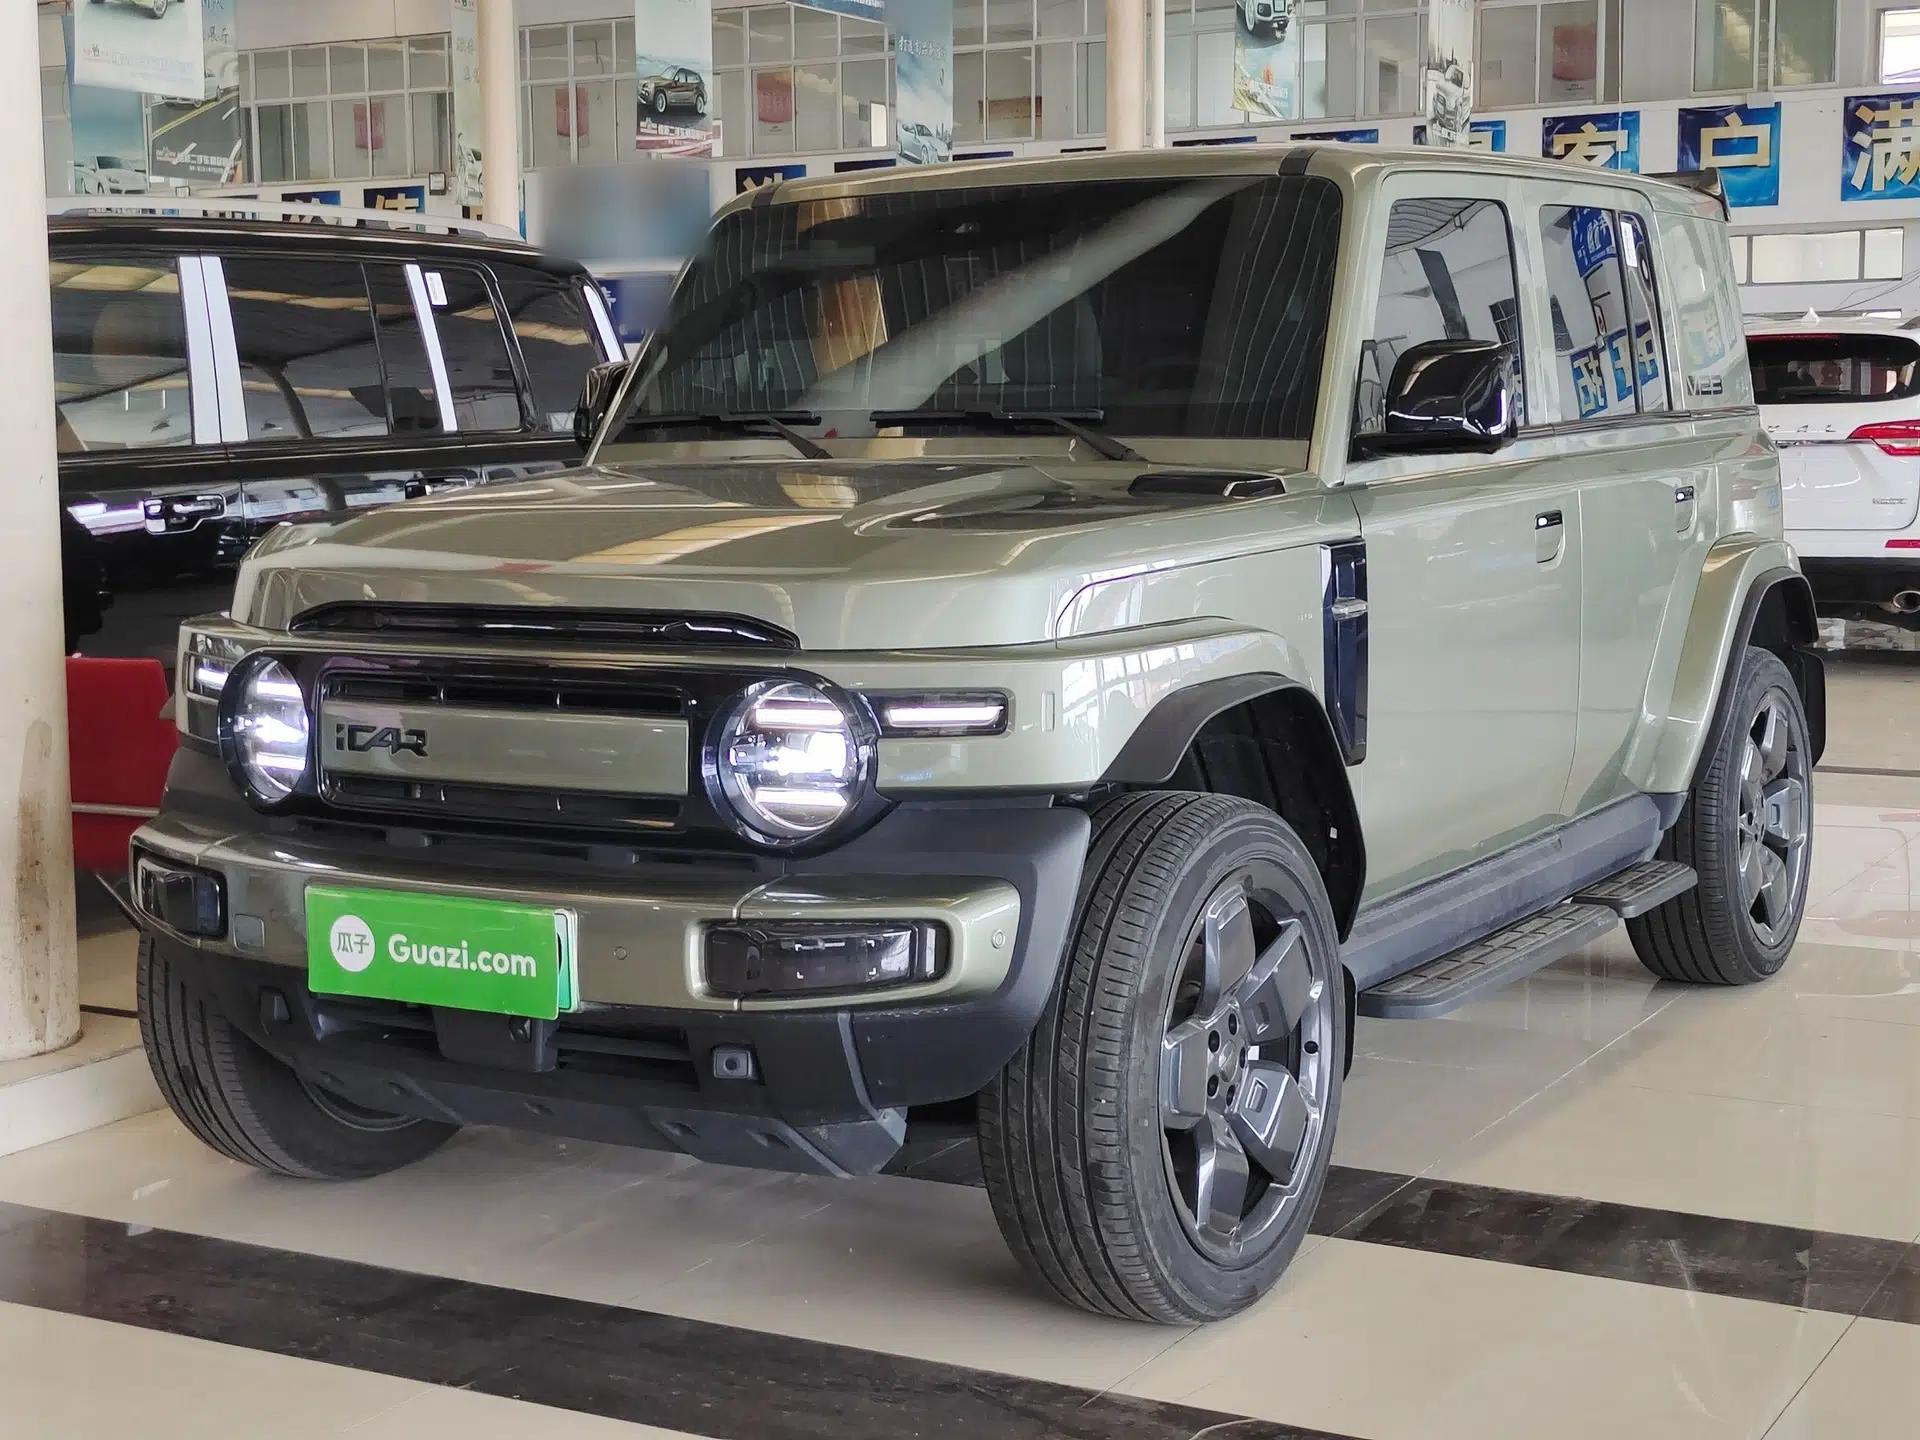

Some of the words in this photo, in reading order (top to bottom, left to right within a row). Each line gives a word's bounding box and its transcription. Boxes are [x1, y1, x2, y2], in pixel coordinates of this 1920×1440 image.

[336, 723, 428, 757] iCAR
[336, 931, 370, 955] 瓜子
[388, 933, 537, 978] Guazi.com
